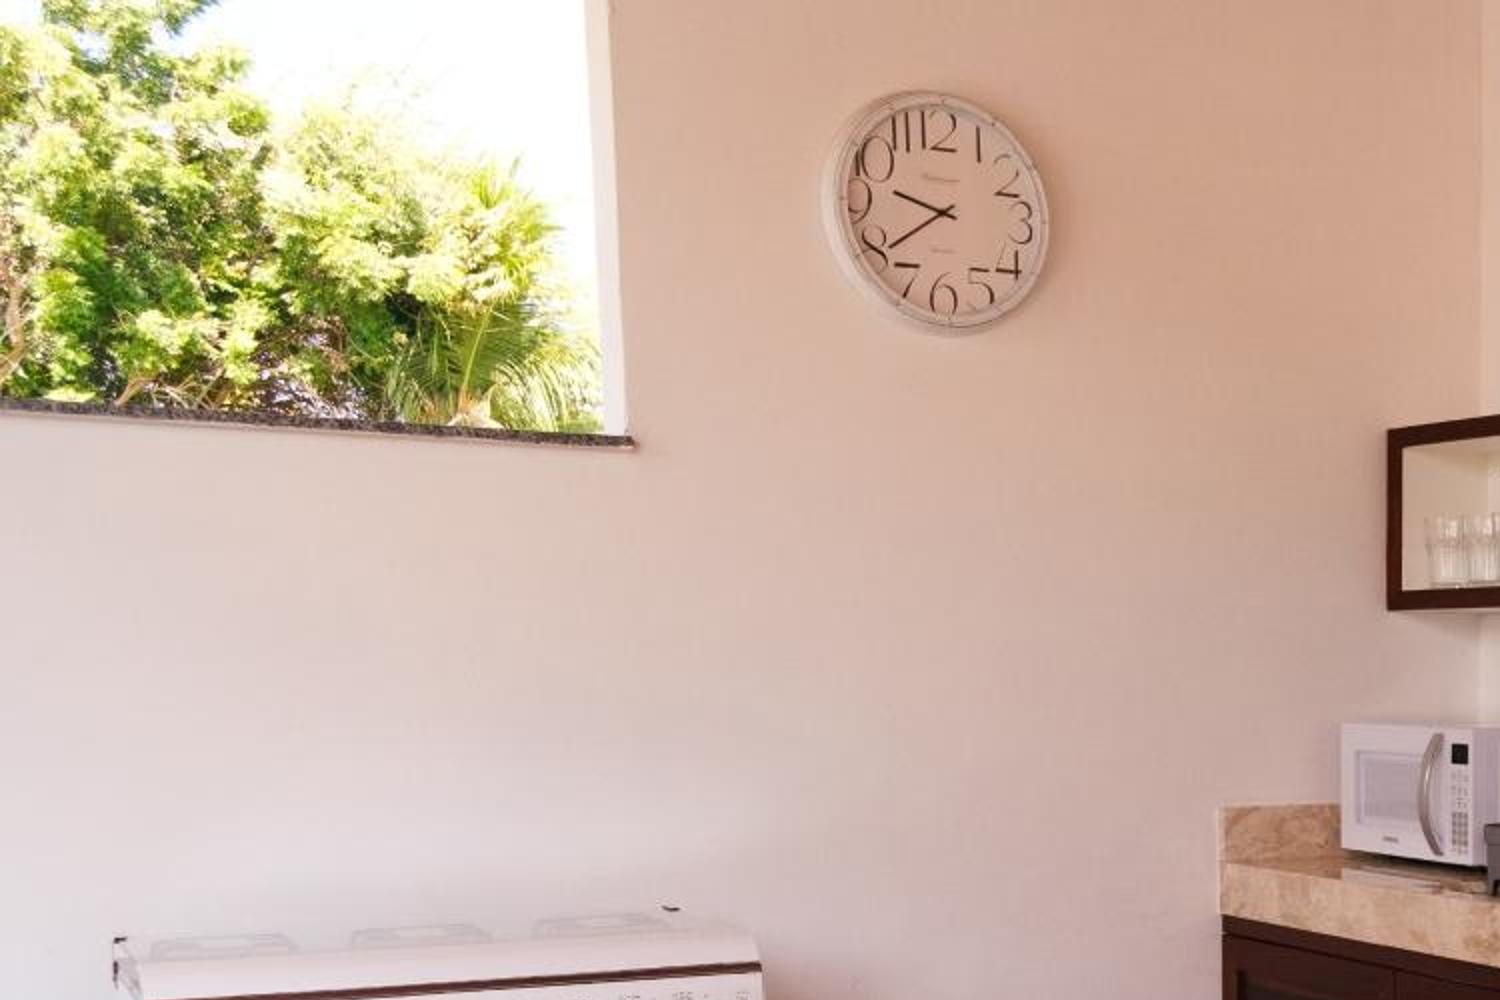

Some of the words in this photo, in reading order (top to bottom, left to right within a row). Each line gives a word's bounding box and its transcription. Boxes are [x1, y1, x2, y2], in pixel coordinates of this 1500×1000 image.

[891, 111, 911, 153] 11
[921, 110, 958, 153] 12
[976, 125, 982, 163] 1
[855, 135, 895, 183] 10
[993, 153, 1020, 198] 2
[848, 178, 872, 224] 9
[1008, 201, 1033, 245] 3
[861, 225, 889, 273] 8
[995, 241, 1023, 281] 4
[894, 262, 921, 299] 7
[929, 272, 959, 316] 6
[967, 267, 995, 311] 5
